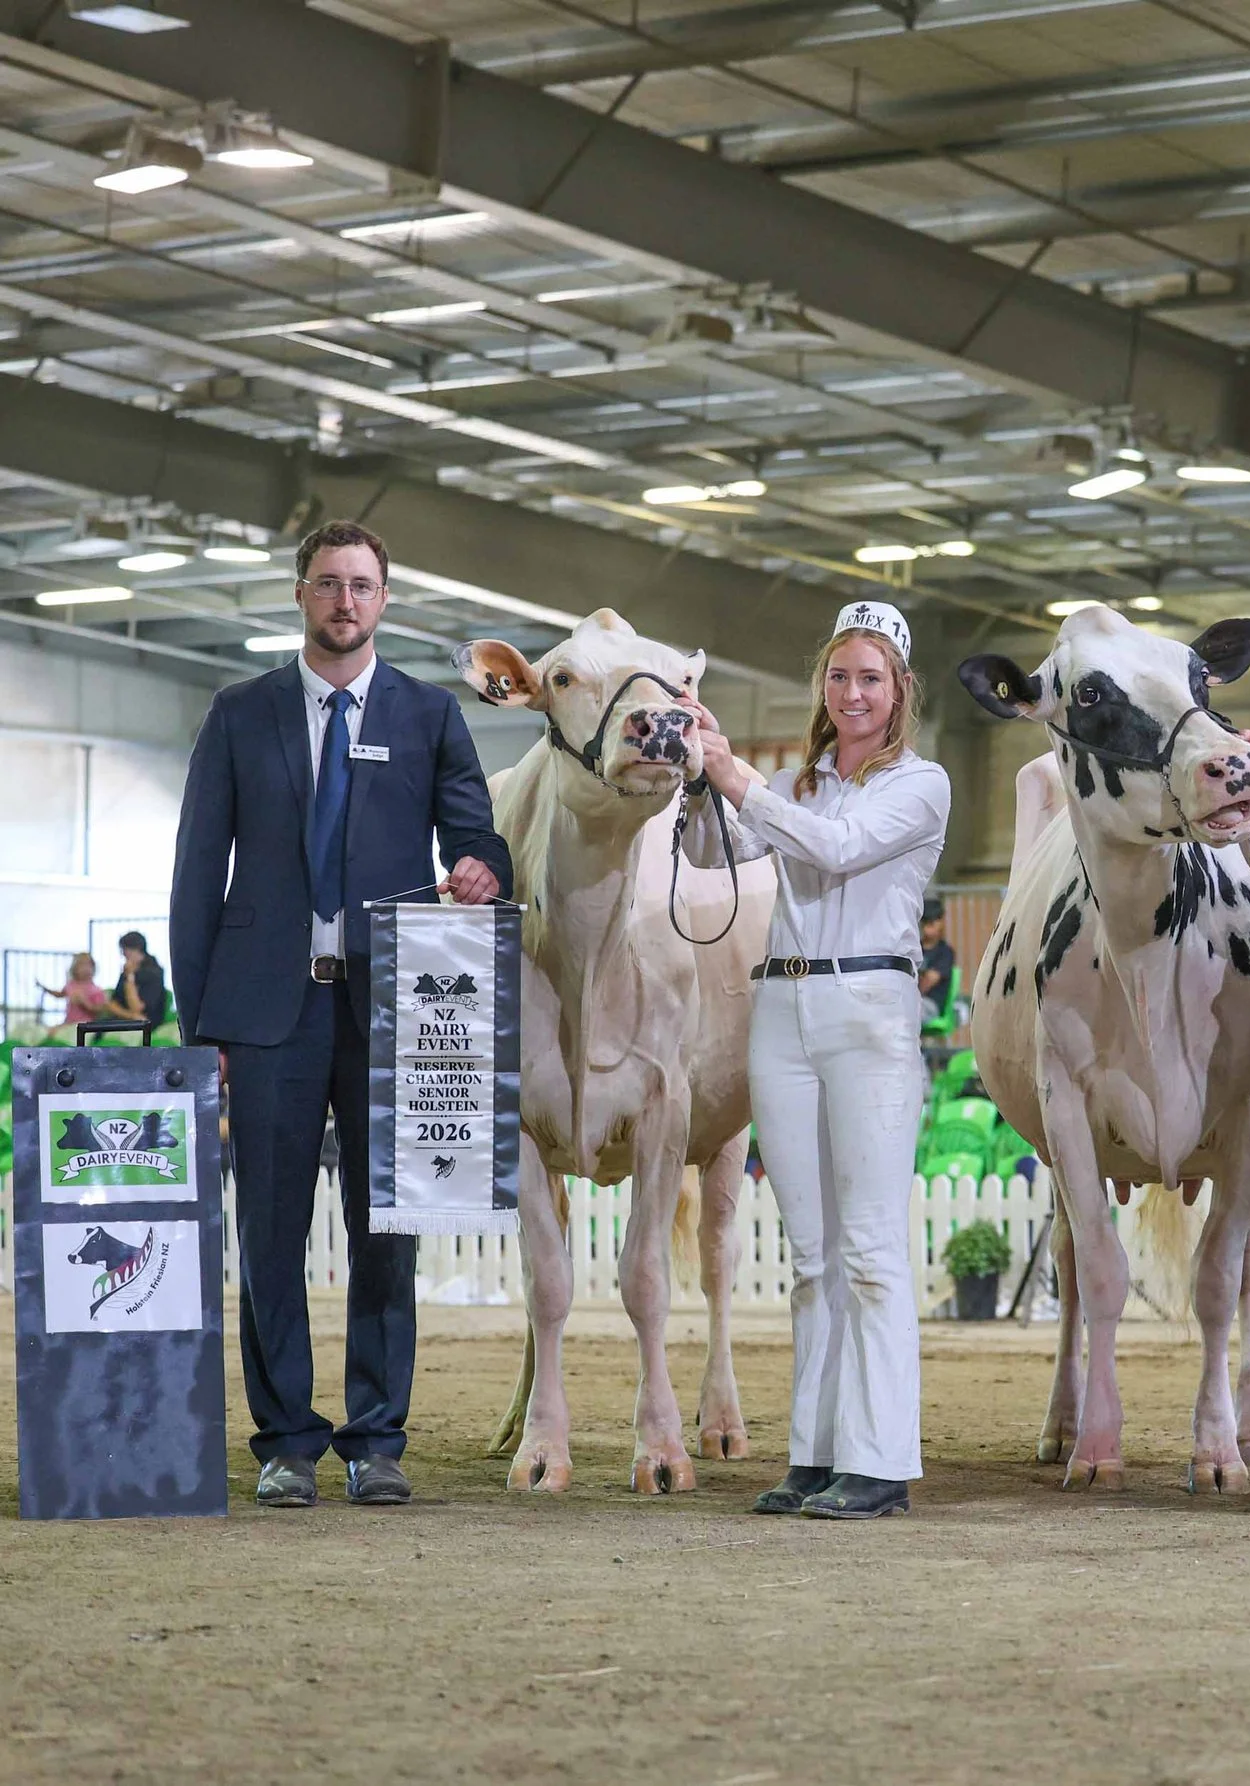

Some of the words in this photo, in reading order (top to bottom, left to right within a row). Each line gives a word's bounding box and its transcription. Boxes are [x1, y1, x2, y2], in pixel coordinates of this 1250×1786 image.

[434, 1008, 456, 1021] NZ
[419, 1023, 470, 1036] DAIRY
[417, 1038, 473, 1051] EVENT
[414, 1061, 475, 1071] RESERVE
[405, 1074, 482, 1085] CHAMPION
[418, 1087, 470, 1098] SENIOR
[408, 1100, 479, 1112] HOLSTEIN
[109, 1123, 128, 1135] NZ
[416, 1122, 472, 1141] 2026
[77, 1152, 162, 1168] DAIRYEVENT
[125, 1291, 154, 1316] Holstein
[150, 1258, 167, 1290] Friesian
[161, 1242, 170, 1256] NZ
